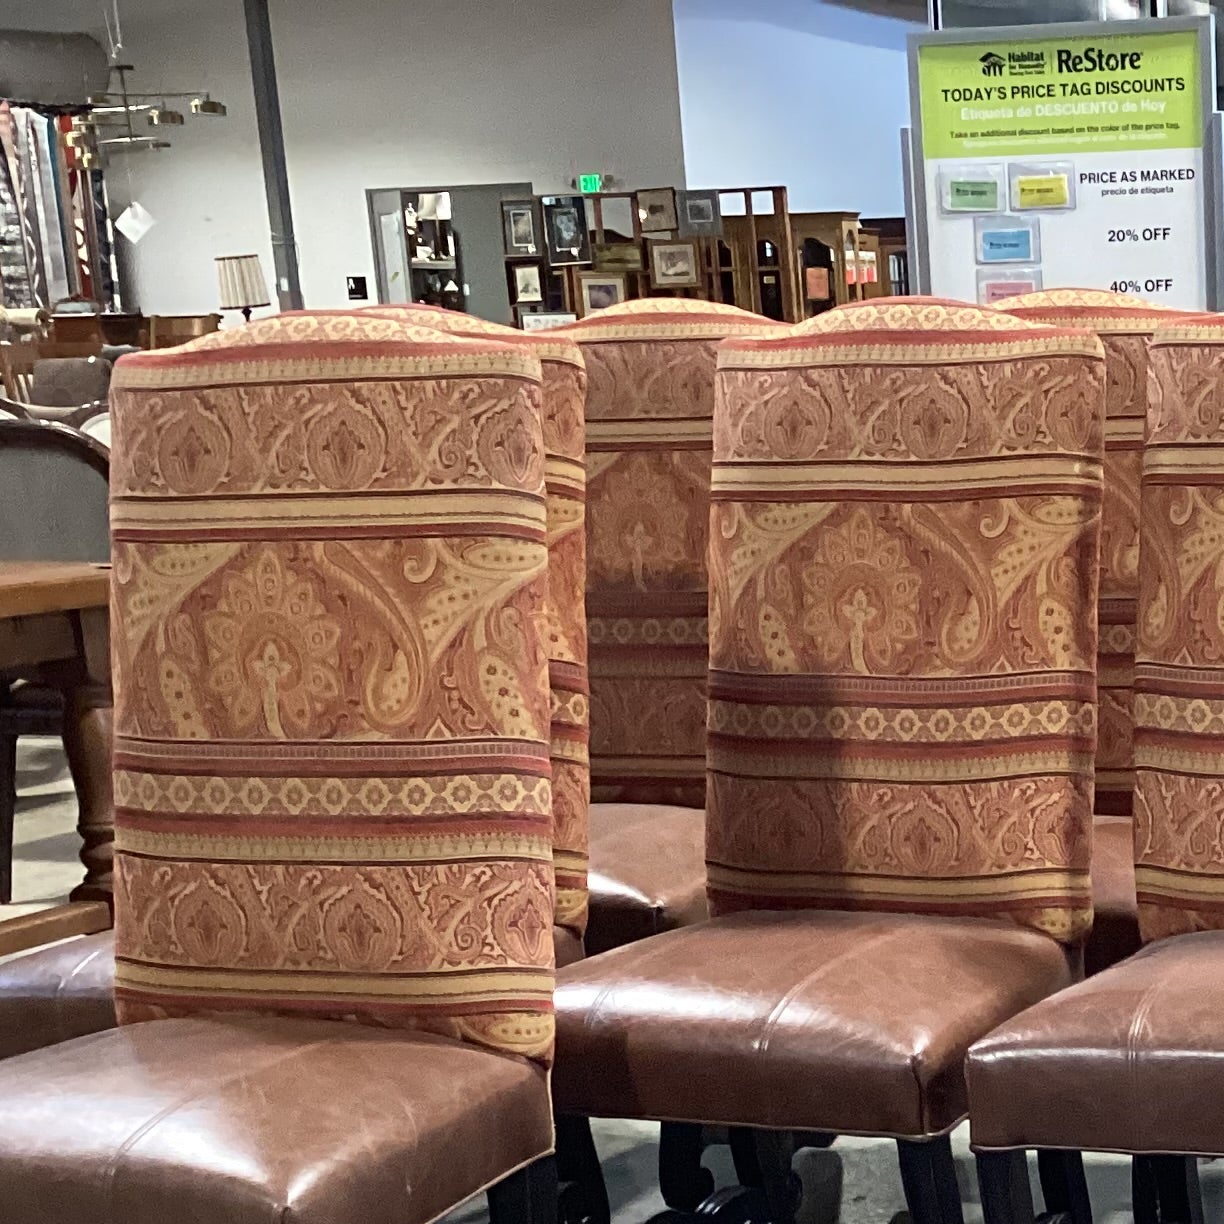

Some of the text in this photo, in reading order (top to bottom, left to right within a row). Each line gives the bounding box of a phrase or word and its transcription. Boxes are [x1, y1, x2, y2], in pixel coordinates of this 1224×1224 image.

[1008, 52, 1044, 62] Habitat
[1057, 48, 1141, 73] ReStore
[941, 78, 1185, 102] TODAY'S PRICE TAG DISCOUNTS
[961, 99, 1166, 120] Etiqueta de DESCUENTO de Hoy
[1079, 168, 1196, 185] PRICE AS MARKED
[1101, 185, 1175, 197] precio de etiqueta
[1107, 227, 1172, 242] 20% OFF
[1109, 278, 1174, 294] 40% OFF
